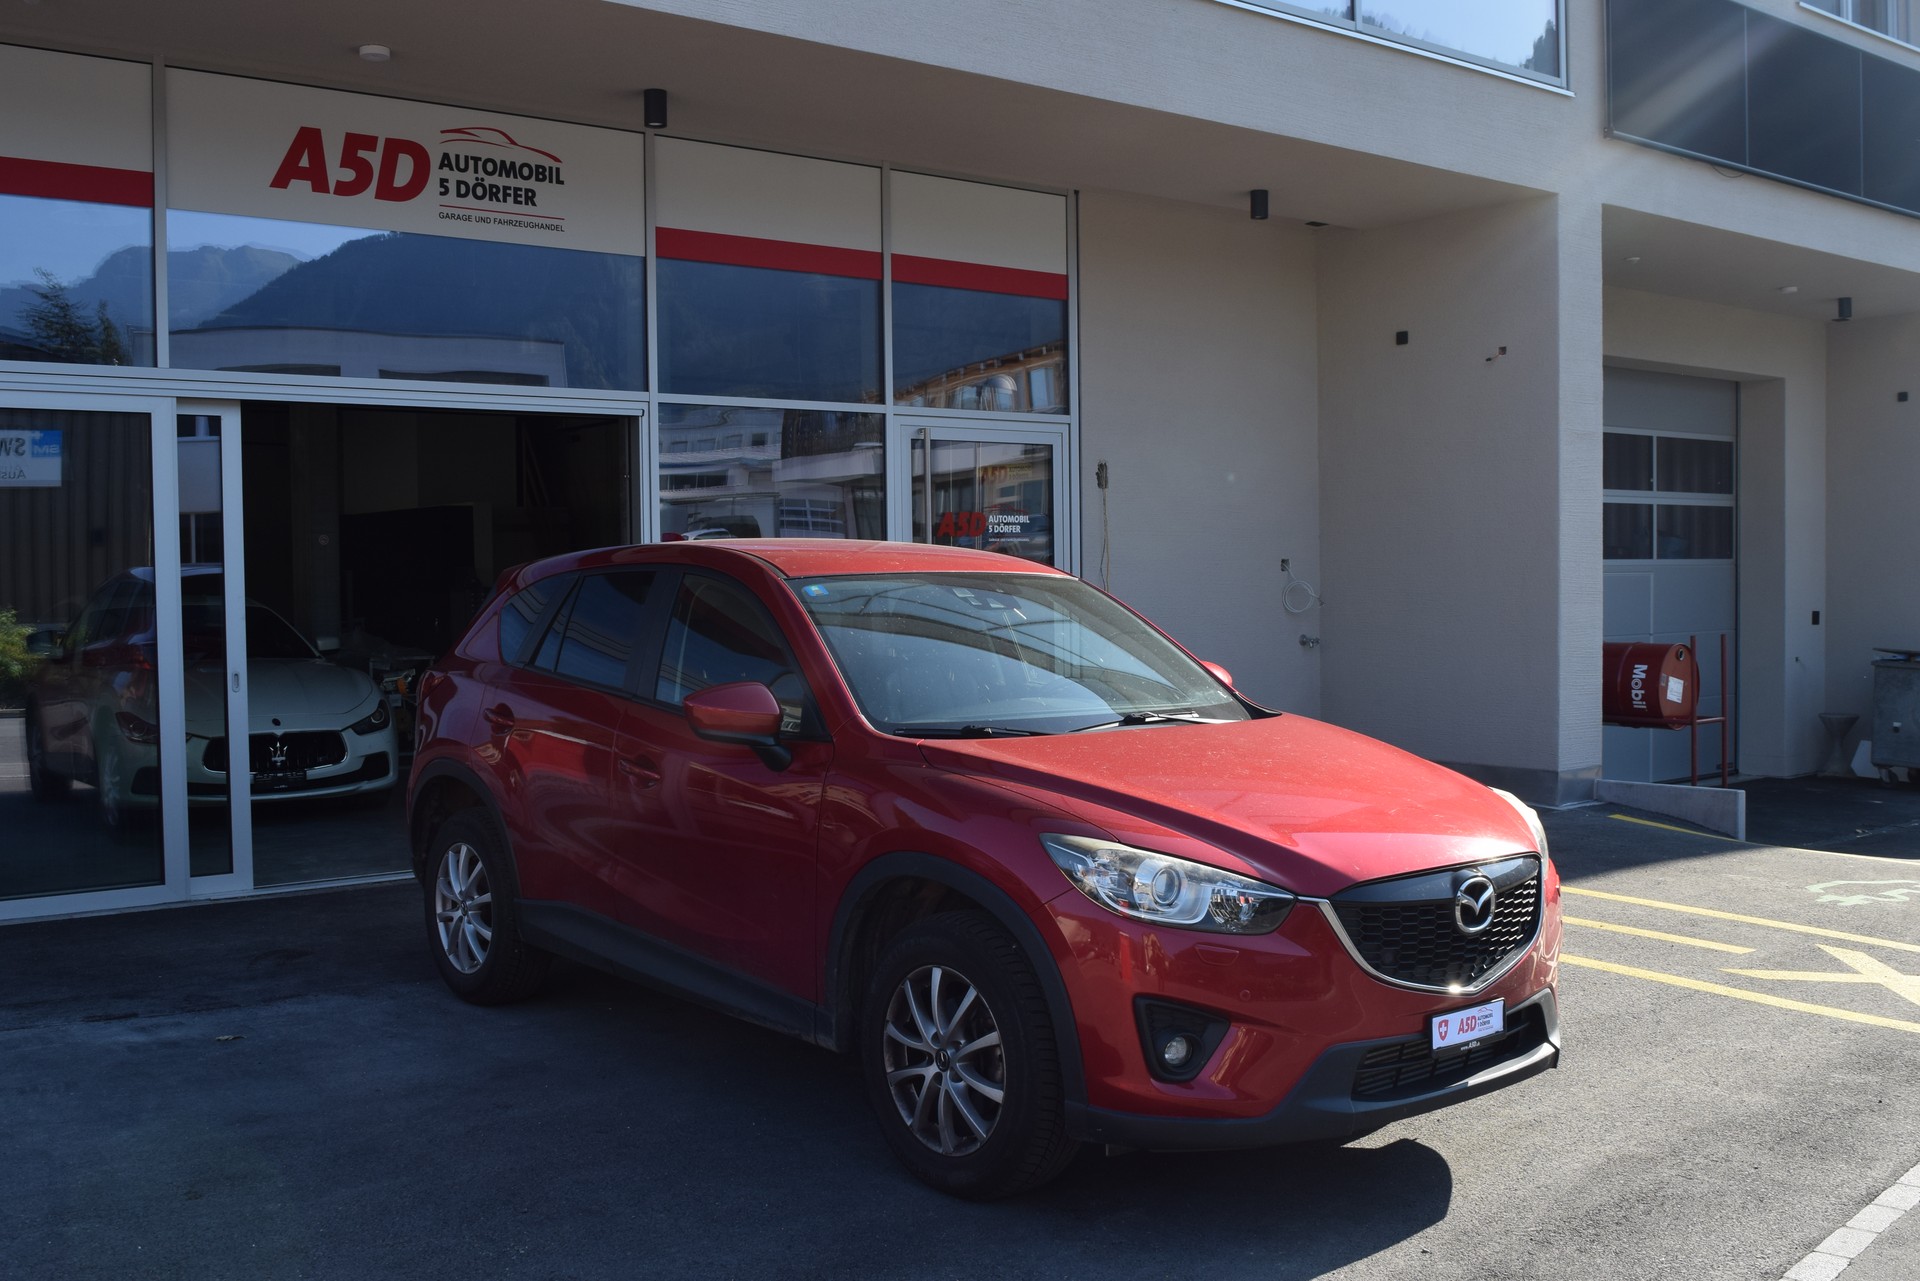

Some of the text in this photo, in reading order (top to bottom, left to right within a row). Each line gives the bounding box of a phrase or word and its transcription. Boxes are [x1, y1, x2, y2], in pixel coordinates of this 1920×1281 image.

[269, 126, 431, 202] A5D
[438, 152, 565, 185] AUTOMOBIL
[439, 176, 537, 207] 5 DÖRFER
[438, 211, 565, 233] GARAGE UND FAHRZEUGHANDEL
[937, 511, 987, 538] A5D
[988, 515, 1030, 523] AUTOMOBIL
[988, 523, 1021, 533] 5 DÖRFER
[1631, 664, 1648, 709] Mobil
[1457, 1015, 1477, 1035] A5D
